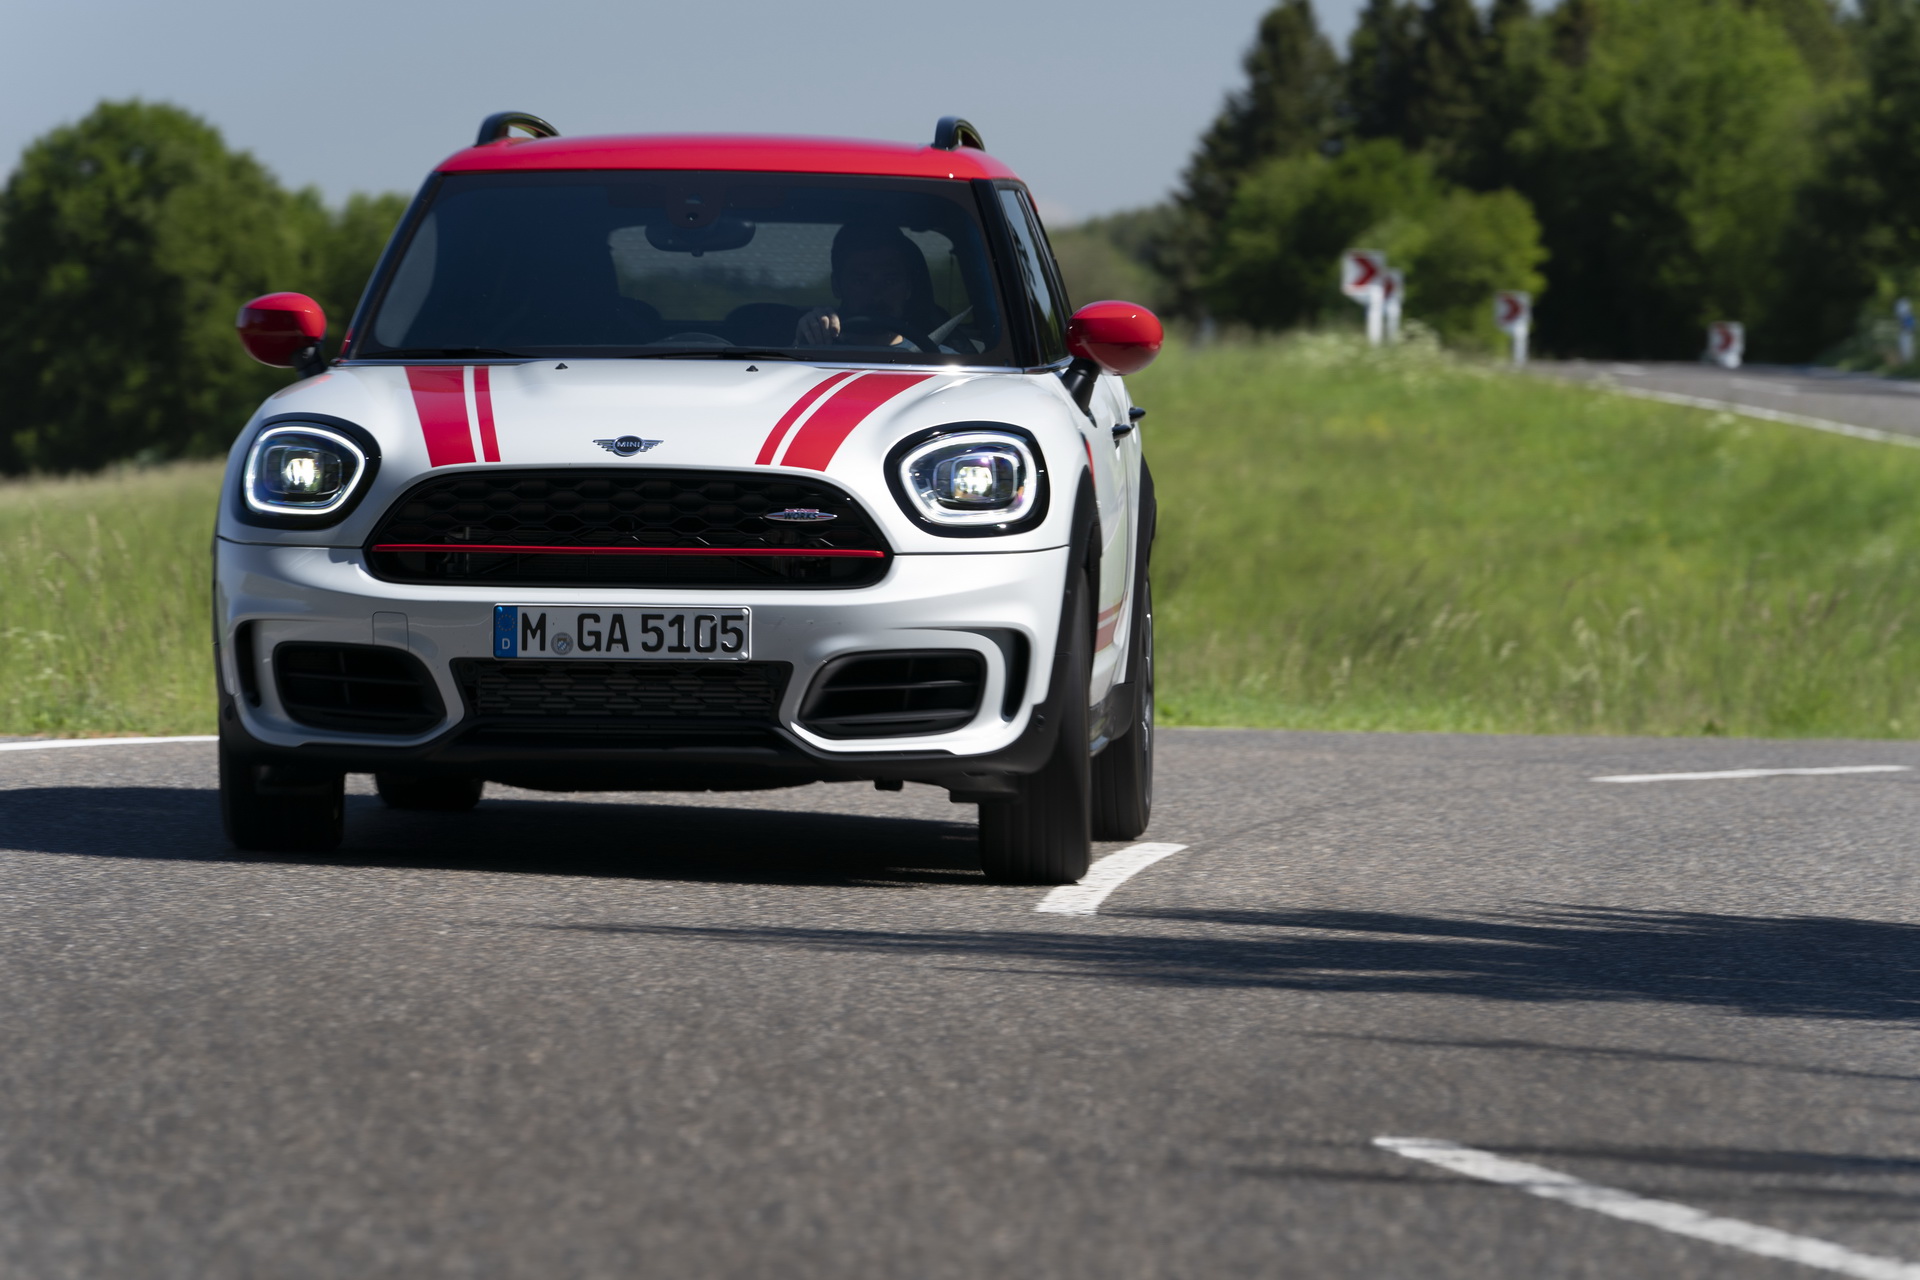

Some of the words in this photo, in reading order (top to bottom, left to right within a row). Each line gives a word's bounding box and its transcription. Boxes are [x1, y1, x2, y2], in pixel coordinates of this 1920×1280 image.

[501, 638, 511, 650] D
[521, 613, 546, 651] M
[577, 613, 630, 652] GA
[640, 614, 745, 653] 5105
